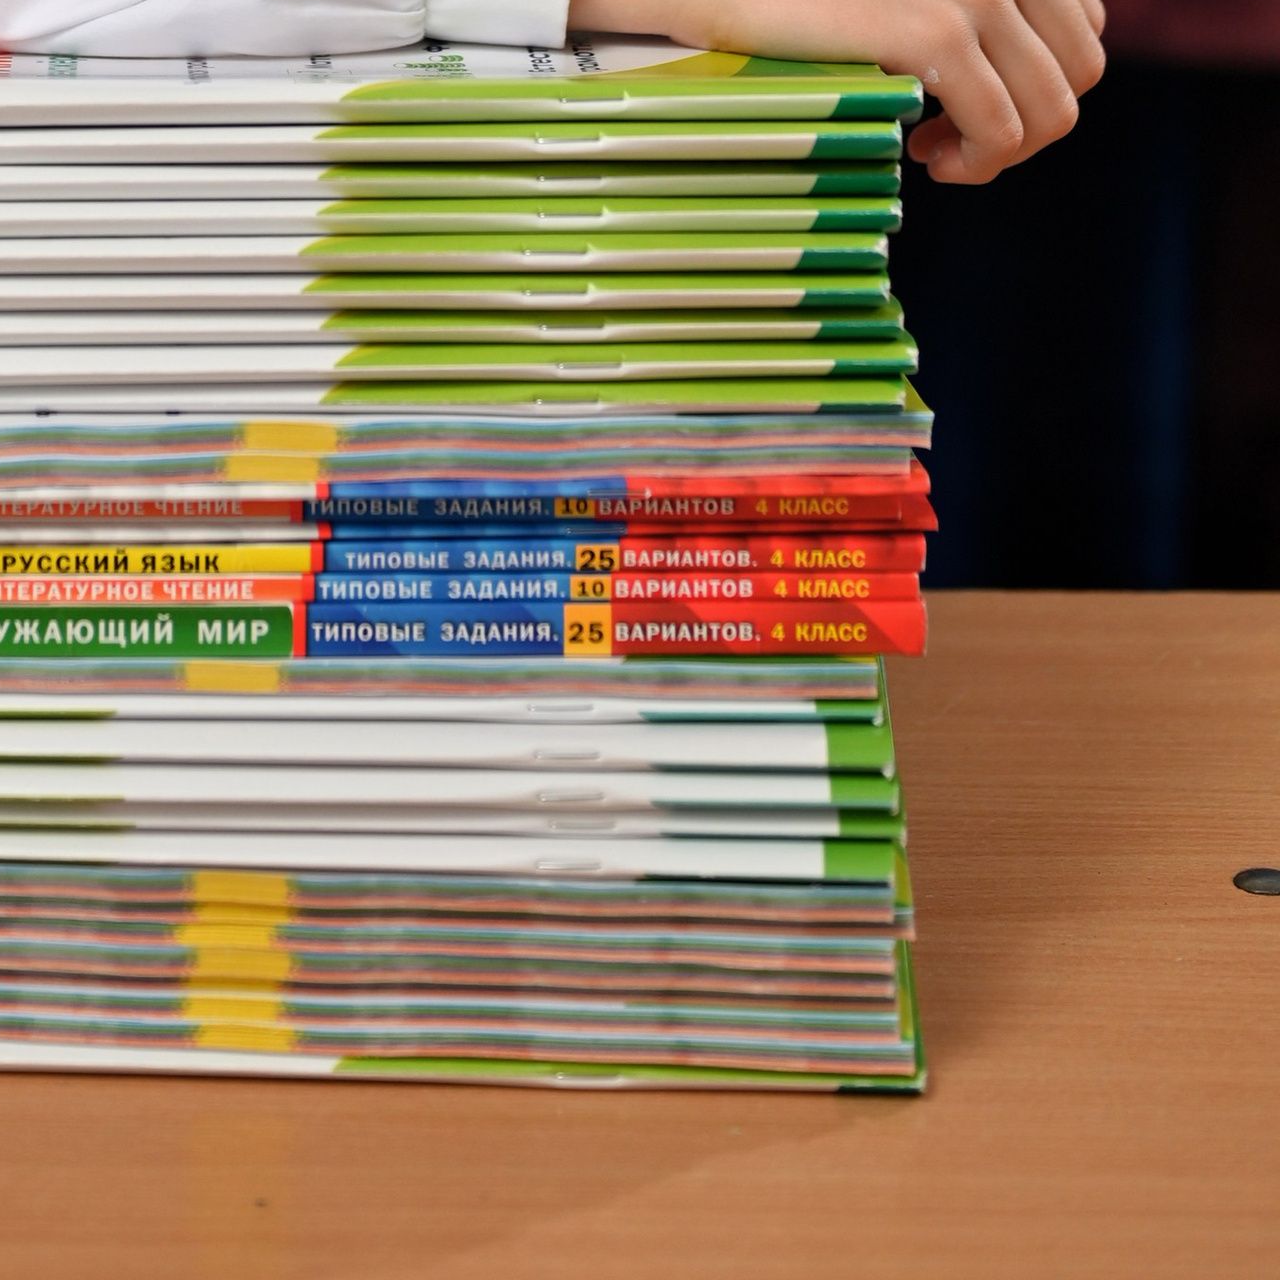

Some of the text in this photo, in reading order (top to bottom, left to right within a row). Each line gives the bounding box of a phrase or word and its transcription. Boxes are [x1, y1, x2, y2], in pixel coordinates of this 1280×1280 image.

[155, 499, 243, 515] ЧТЕНИЕ
[309, 498, 419, 515] ТИПОВЫЕ
[434, 498, 550, 518] ЗАДАНИЯ.
[560, 498, 588, 515] 10
[599, 498, 734, 515] ВАРИАНТОВ
[755, 498, 768, 515] 4
[779, 498, 849, 515] КЛАСС
[2, 548, 129, 573] РУССКИЙ
[141, 554, 219, 573] ЯЗЫК
[345, 551, 449, 569] ТИПОВЫЕ
[463, 550, 572, 570] ЗАДАНИЯ.
[580, 549, 615, 572] 25
[623, 549, 757, 568] ВАРИАНТОВ.
[770, 549, 784, 568] 4
[794, 549, 866, 568] КЛАСС
[162, 580, 254, 600] ЧТЕНИЕ
[319, 580, 433, 600] ТИПОВЫЕ
[447, 579, 566, 601] ЗАДАНИЯ.
[577, 581, 604, 597] 10
[615, 579, 754, 598] ВАРИАНТОВ
[774, 579, 788, 598] 4
[798, 579, 869, 598] КЛАСС
[198, 619, 269, 645] МИР
[311, 622, 425, 642] ТИПОВЫЕ
[440, 622, 558, 645] ЗАДАНИЯ.
[569, 622, 604, 644] 25
[615, 622, 761, 642] ВАРИАНТОВ.
[771, 622, 785, 641] 4
[795, 622, 867, 642] КЛАСС
